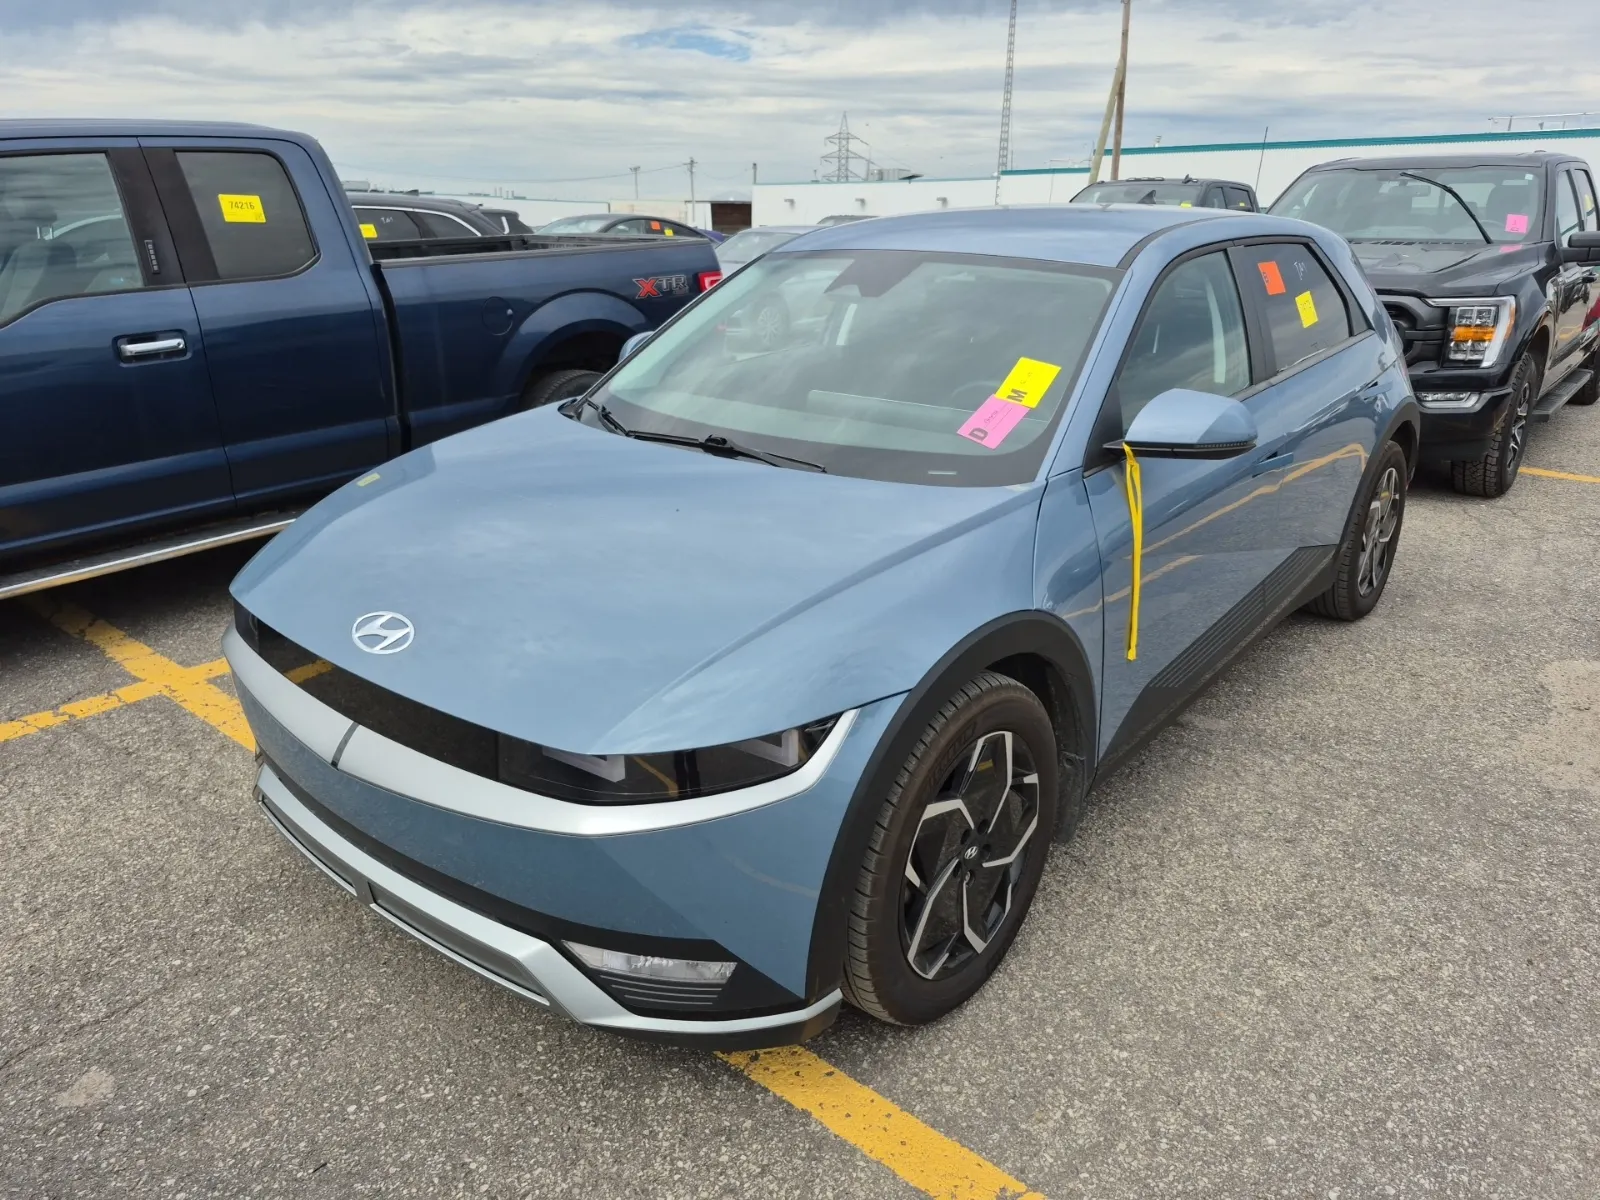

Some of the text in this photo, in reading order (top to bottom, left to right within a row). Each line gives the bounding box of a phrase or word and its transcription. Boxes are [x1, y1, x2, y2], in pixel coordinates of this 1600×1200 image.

[229, 201, 255, 211] 74216
[633, 274, 688, 298] XTR
[1007, 388, 1027, 403] M
[968, 427, 989, 442] D
